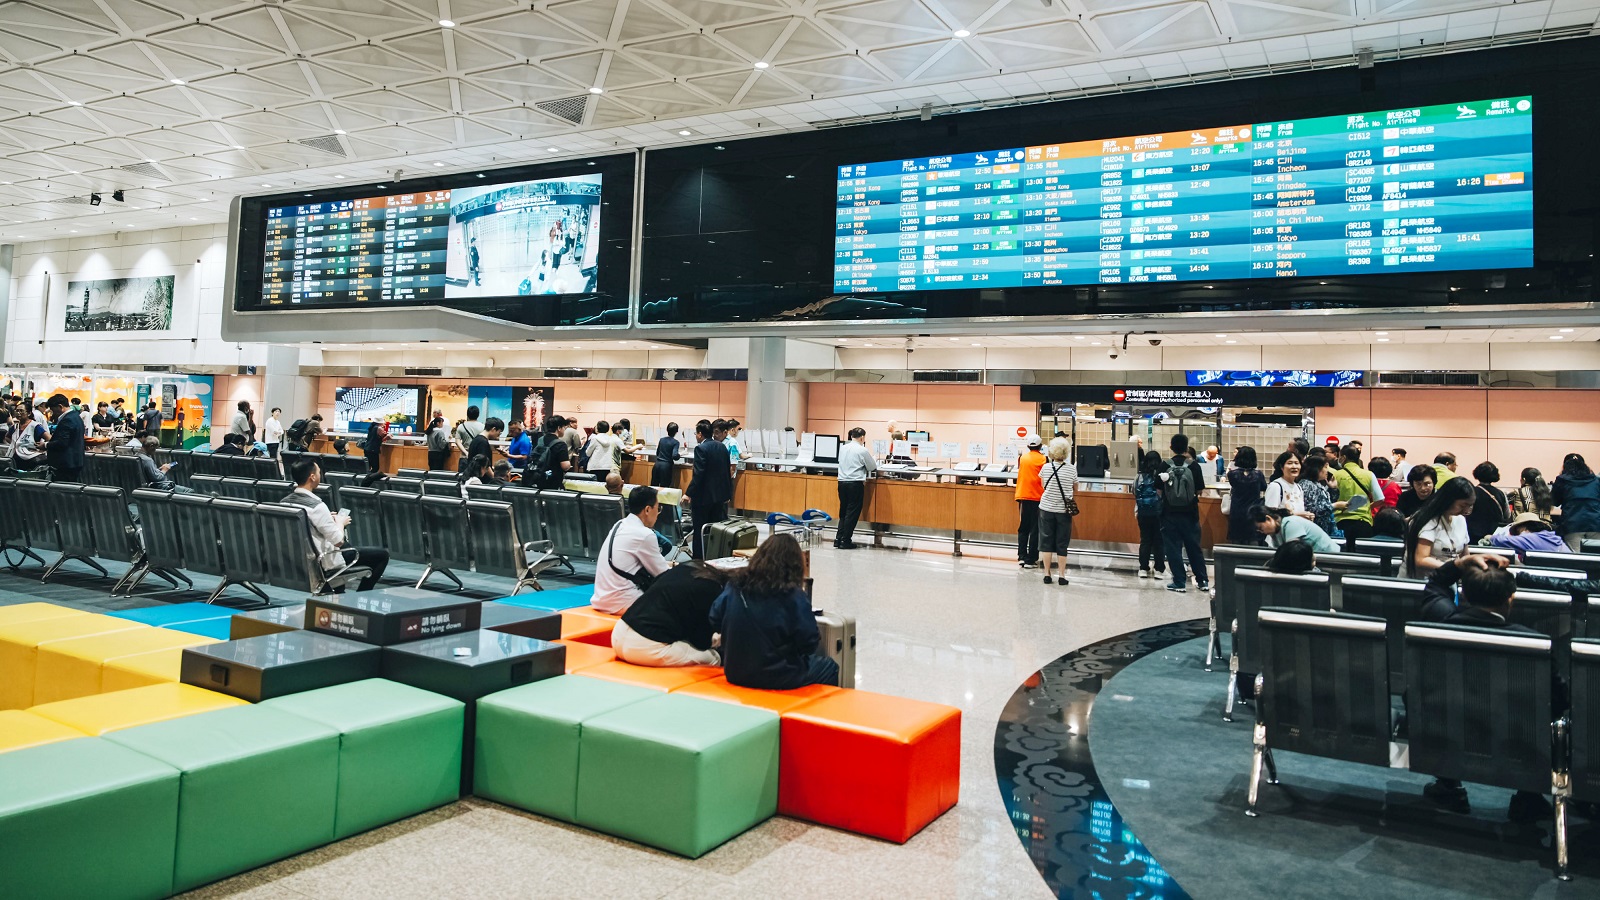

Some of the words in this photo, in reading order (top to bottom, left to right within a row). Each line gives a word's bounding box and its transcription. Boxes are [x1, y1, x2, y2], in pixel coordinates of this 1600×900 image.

[1349, 132, 1370, 140] CI512
[1349, 150, 1370, 158] OZ713
[1191, 164, 1210, 172] 13:07
[1349, 168, 1375, 176] SC4085
[1457, 177, 1480, 186] 16:26
[1277, 199, 1315, 207] Amsterdam
[339, 624, 349, 634] lying
[431, 625, 444, 634] lying
